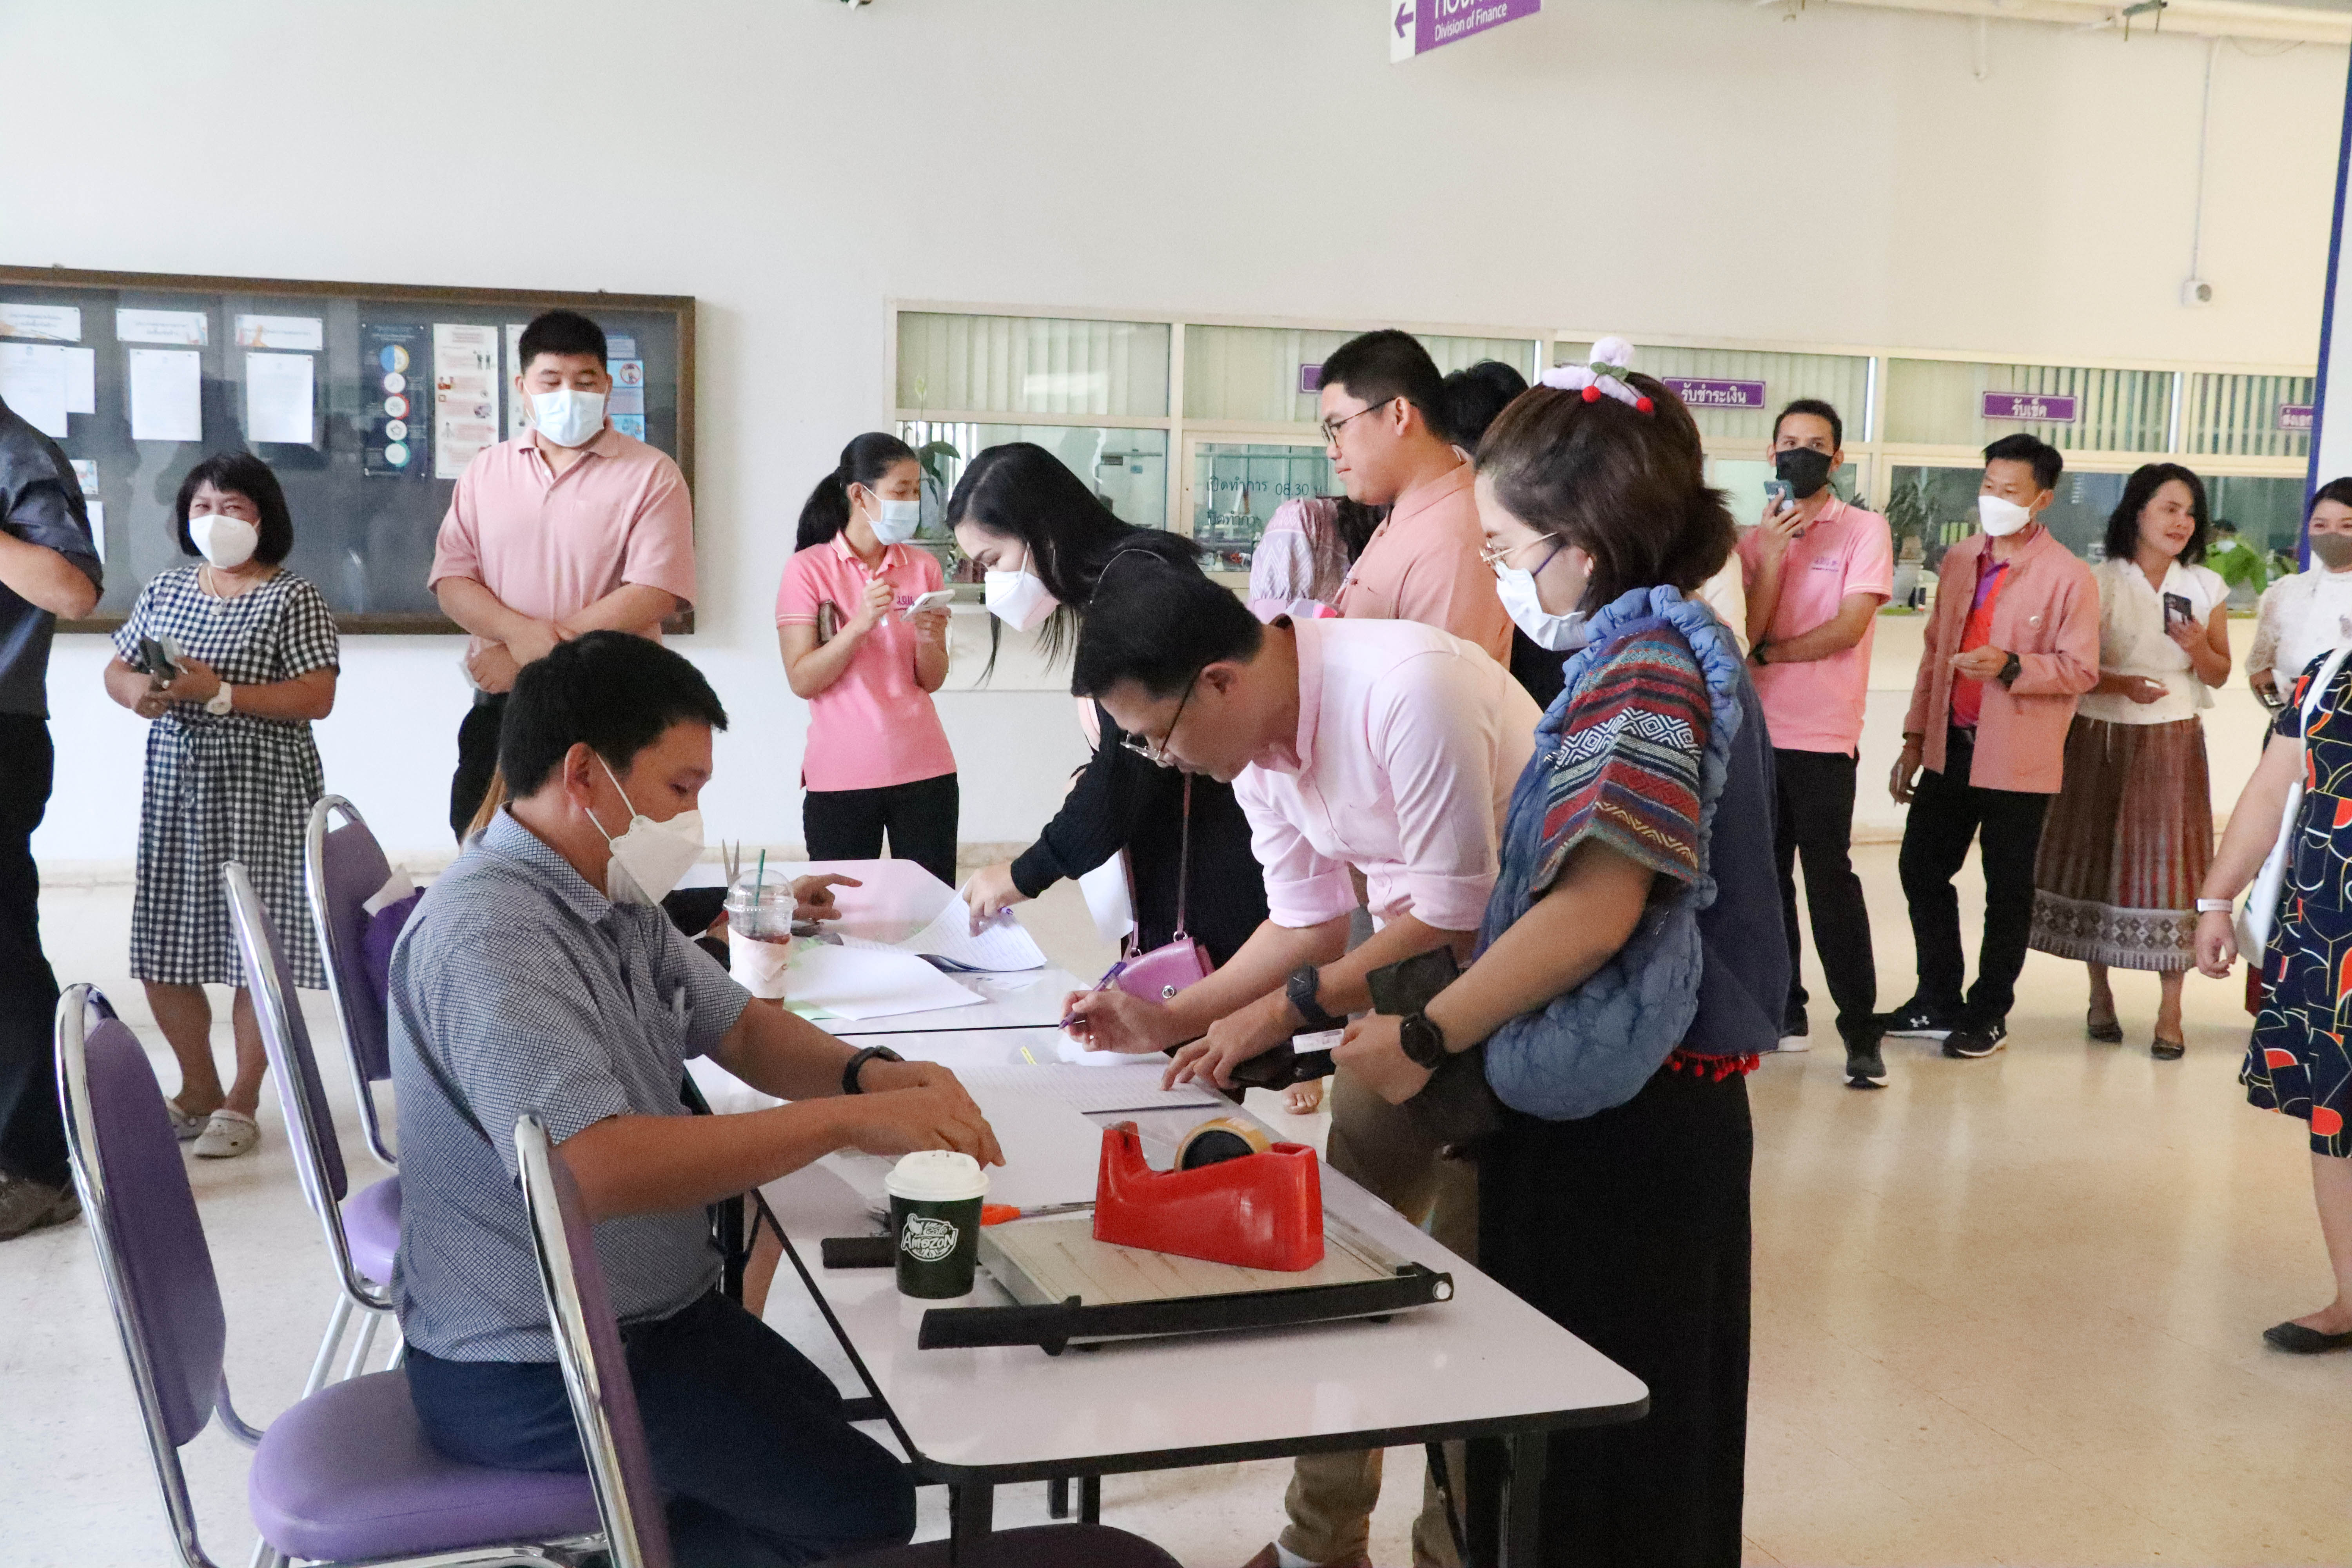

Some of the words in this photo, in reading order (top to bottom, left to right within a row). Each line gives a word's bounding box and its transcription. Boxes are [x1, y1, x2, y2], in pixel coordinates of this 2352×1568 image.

[1435, 19, 1465, 41] Division
[1466, 9, 1475, 30] of
[1476, 3, 1508, 26] Finance
[1681, 382, 1746, 404] รับชำระเงิน
[1275, 483, 1309, 496] 08.30
